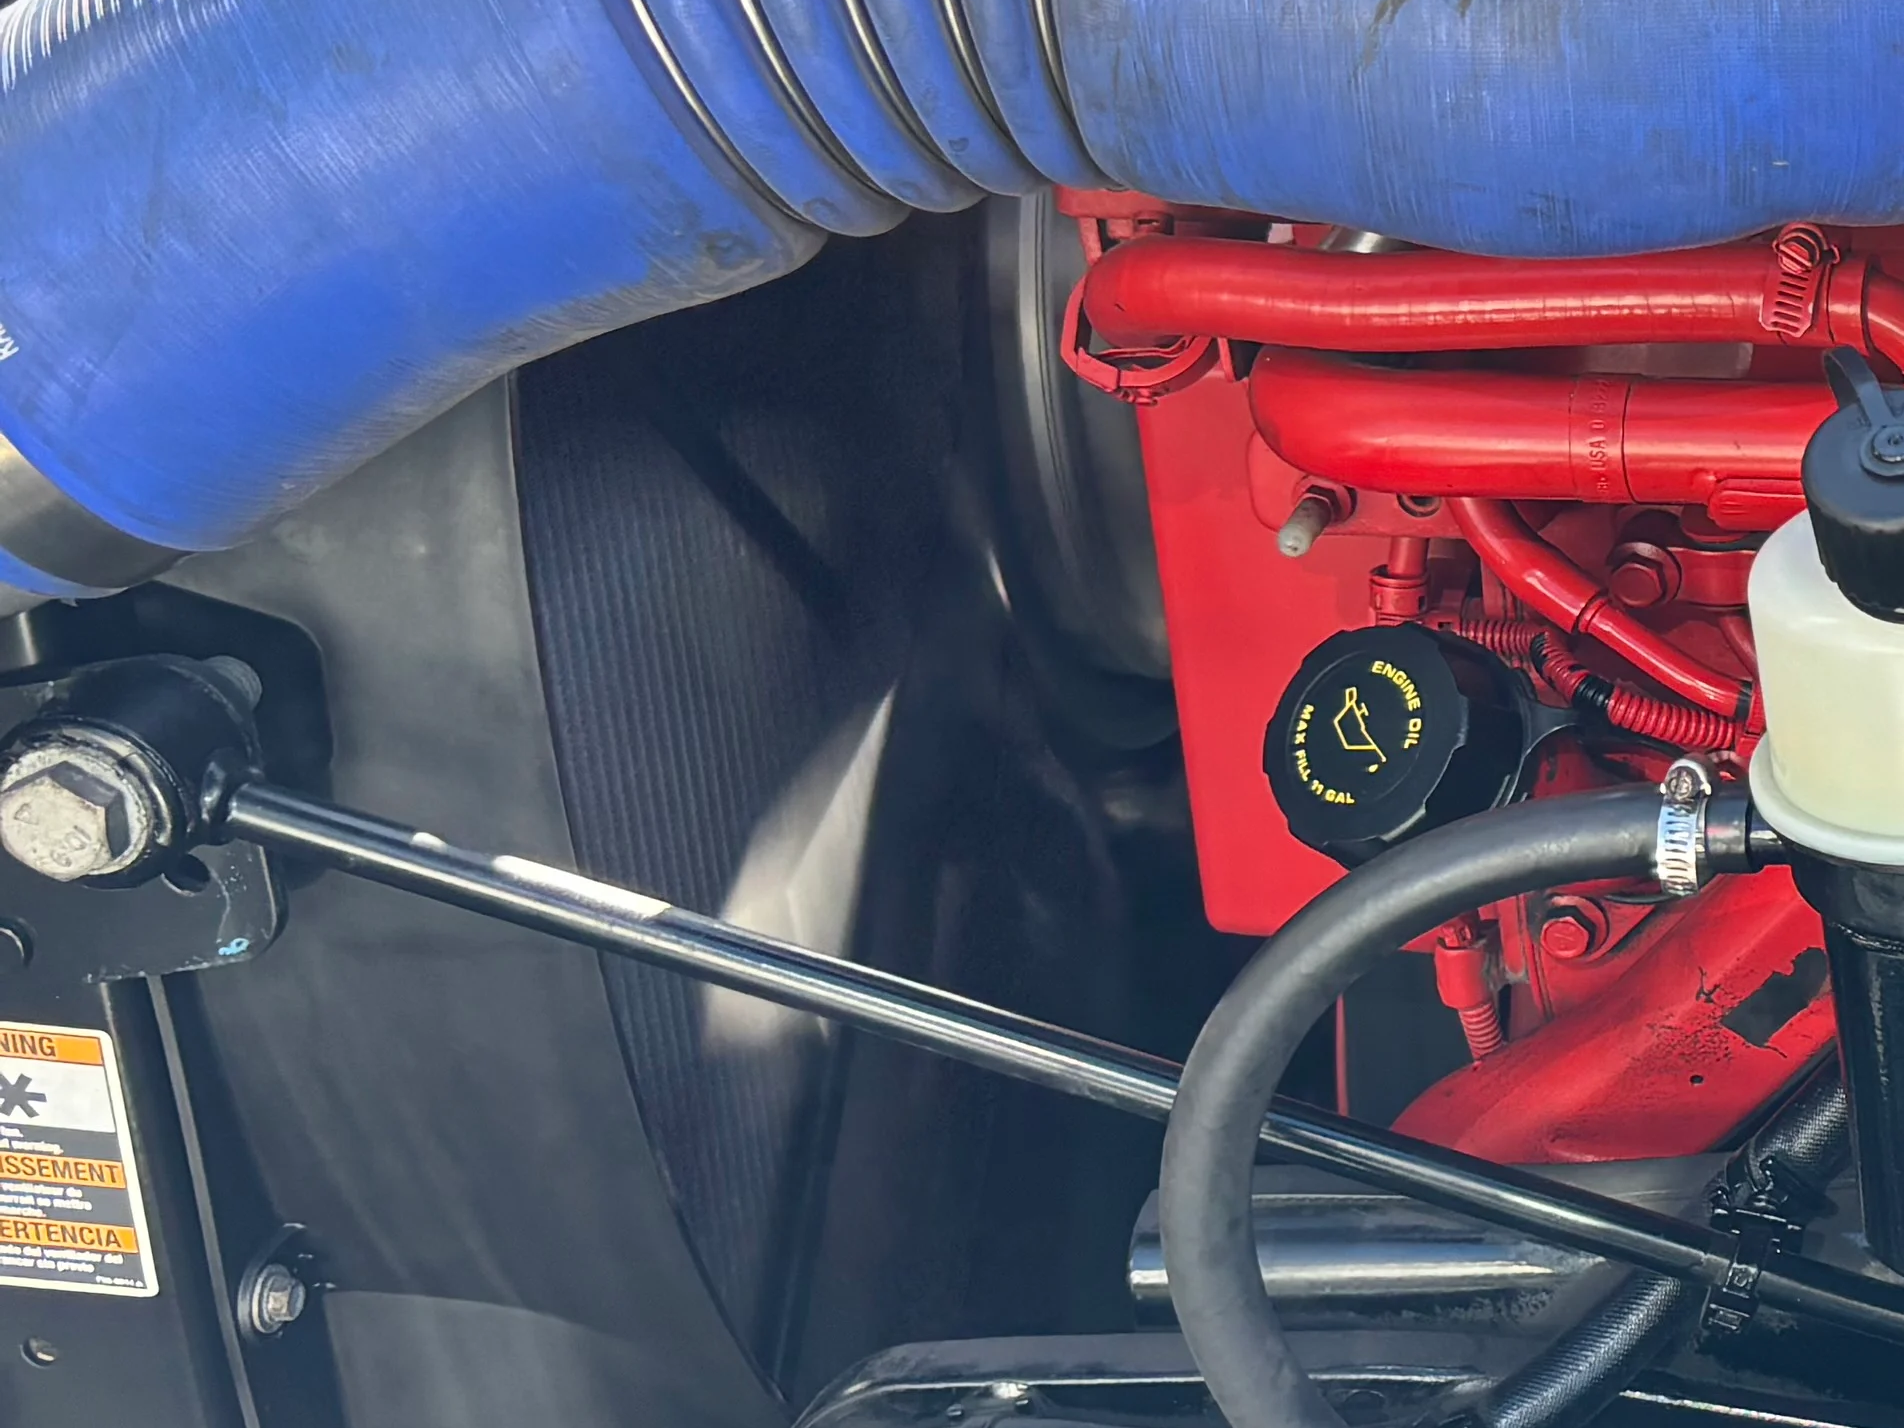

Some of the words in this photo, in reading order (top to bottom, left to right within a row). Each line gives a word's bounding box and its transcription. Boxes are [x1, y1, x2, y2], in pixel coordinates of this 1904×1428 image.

[1372, 661, 1421, 711] ENGINE
[1404, 718, 1421, 749] OIL
[1294, 704, 1314, 745] MAX
[1294, 749, 1311, 782] FILL
[1311, 779, 1325, 795] 11
[1325, 789, 1355, 804] GAL
